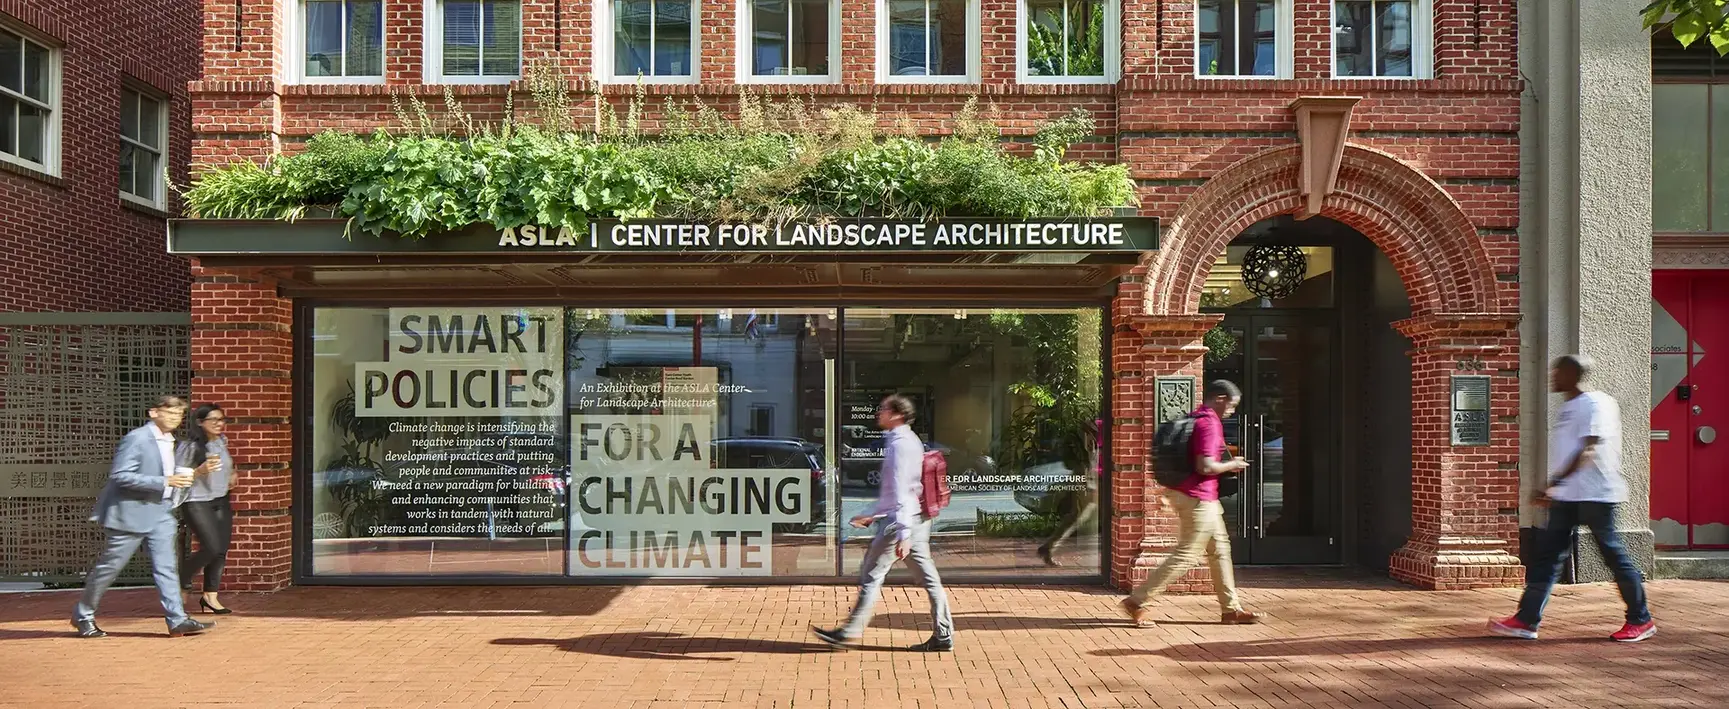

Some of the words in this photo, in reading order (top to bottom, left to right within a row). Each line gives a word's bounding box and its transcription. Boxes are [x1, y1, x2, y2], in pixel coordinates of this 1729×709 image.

[498, 224, 576, 247] ASLA
[610, 224, 711, 247] CENTER
[717, 223, 769, 246] FOR
[775, 223, 927, 246] LANDSCAPE
[933, 223, 1125, 246] ARCHITECTURE
[398, 314, 555, 354] SMART
[364, 368, 555, 409] POLICIES
[579, 383, 594, 393] An
[596, 382, 648, 393] Exhibition
[650, 383, 662, 393] at
[664, 382, 680, 393] the
[681, 383, 711, 393] ASLA
[712, 383, 746, 393] Center
[579, 396, 594, 409] for
[596, 396, 650, 409] Landscape
[650, 396, 713, 408] Architecture
[1454, 412, 1486, 422] ASLA
[389, 422, 427, 432] Climate
[430, 422, 465, 436] change
[467, 422, 474, 432] is
[477, 422, 536, 436] intensifying
[538, 422, 554, 432] the
[412, 437, 454, 449] negative
[456, 437, 495, 449] impacts
[497, 436, 508, 449] of
[509, 436, 554, 447] standard
[580, 422, 662, 461] FOR
[672, 422, 703, 461] A
[385, 451, 447, 464] development
[450, 452, 493, 464] practices
[496, 451, 515, 461] and
[518, 452, 554, 464] putting
[399, 465, 430, 478] people
[433, 465, 451, 475] and
[454, 465, 517, 475] communities
[519, 465, 529, 475] at
[532, 465, 553, 475] risk.
[952, 475, 970, 483] FOR
[971, 475, 1022, 483] LANDSCAPE
[1023, 475, 1087, 483] ARCHITECTURE
[372, 480, 390, 490] We
[390, 480, 412, 490] need
[446, 480, 493, 492] paradigm
[496, 480, 510, 492] for
[513, 480, 554, 492] building
[392, 494, 411, 504] and
[413, 494, 464, 507] enhancing
[467, 494, 530, 504] communities
[533, 494, 554, 504] that
[578, 475, 802, 516] CHANGING
[406, 508, 436, 518] works
[438, 508, 449, 518] in
[451, 508, 488, 518] tandem
[491, 508, 513, 518] with
[516, 508, 554, 518] natural
[368, 524, 406, 536] systems
[409, 523, 427, 533] and
[430, 523, 475, 533] considers
[478, 523, 492, 533] the
[495, 523, 523, 533] needs
[525, 523, 537, 536] of
[538, 523, 553, 533] all.
[578, 529, 764, 569] CLIMATE
